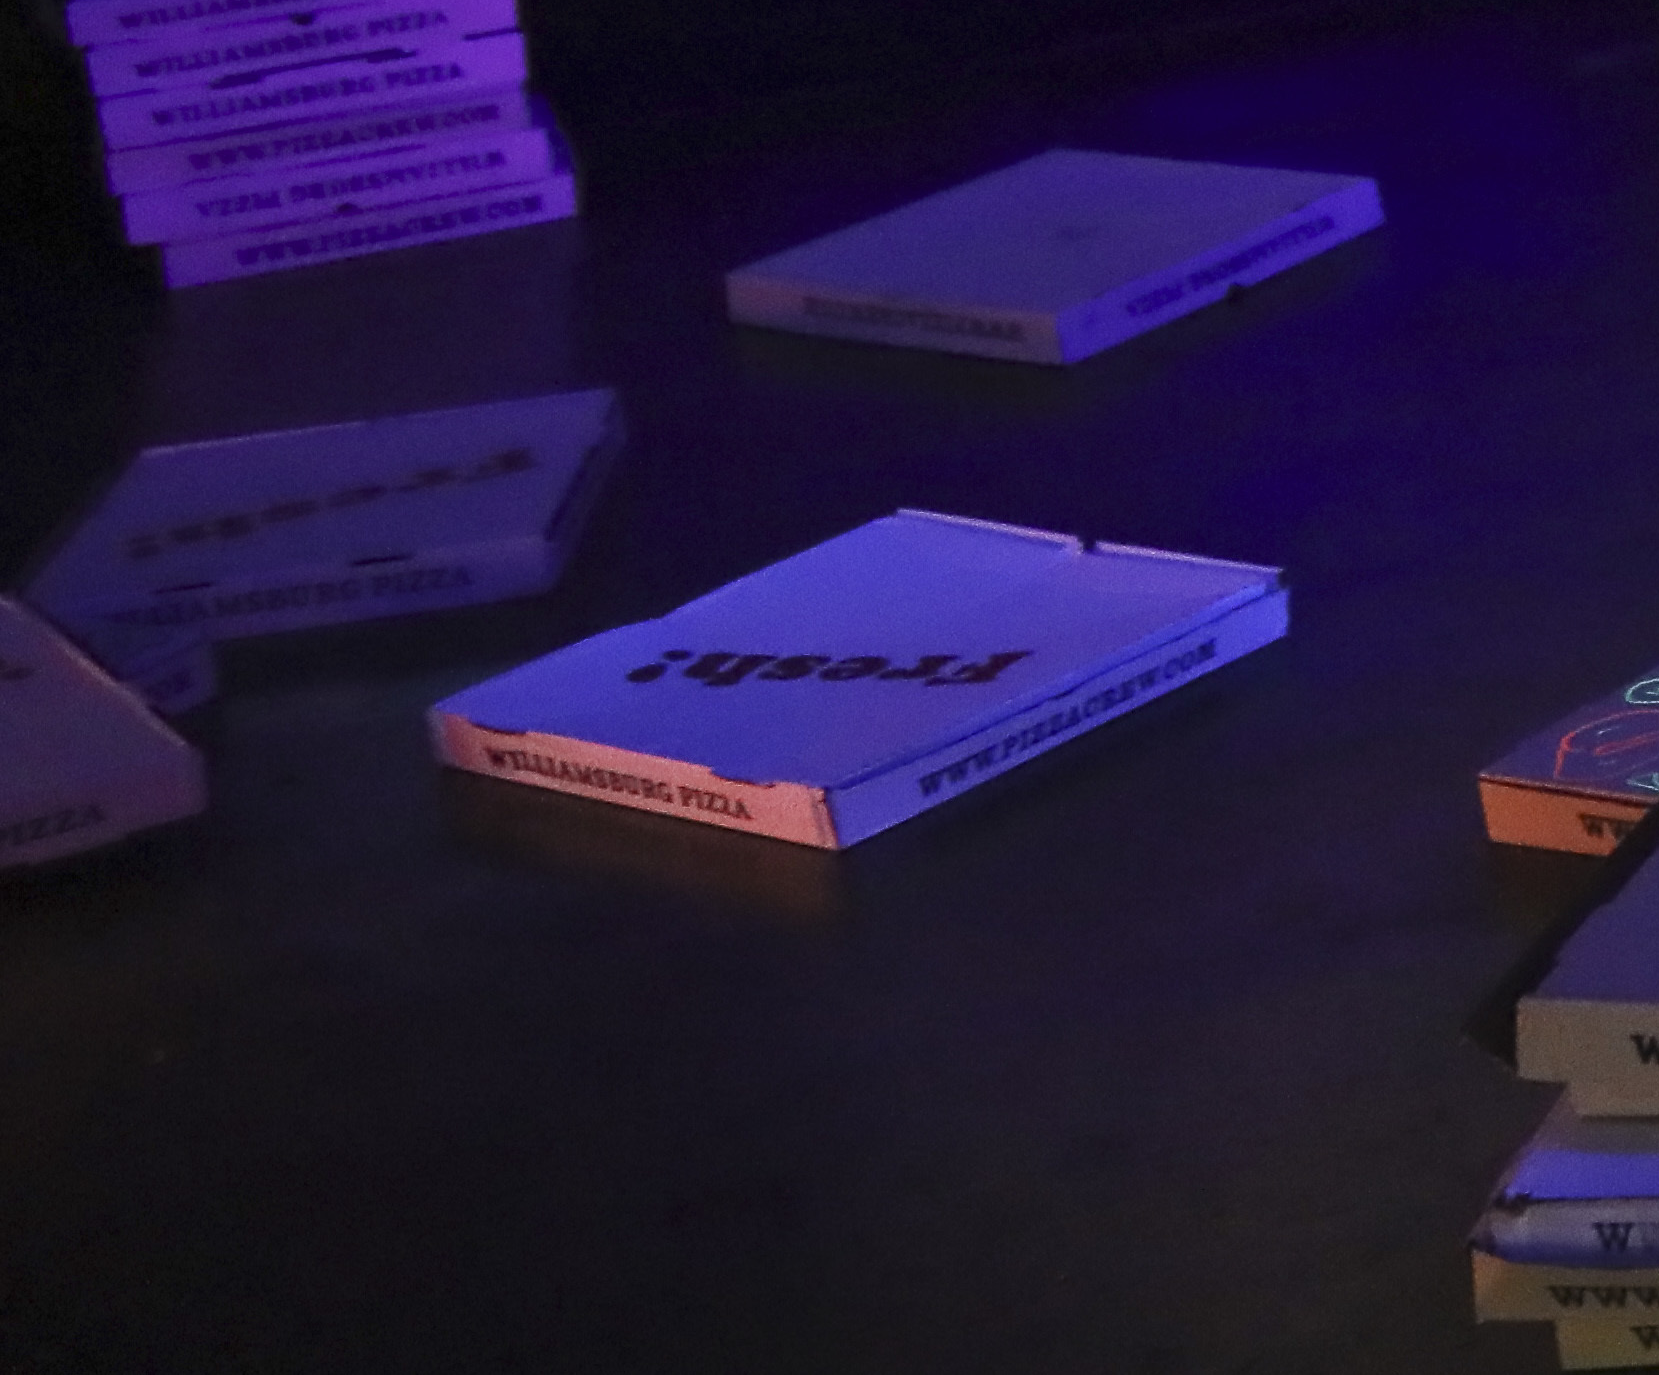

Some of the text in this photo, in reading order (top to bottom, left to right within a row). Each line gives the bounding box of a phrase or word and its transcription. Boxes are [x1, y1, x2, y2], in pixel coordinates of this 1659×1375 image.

[386, 63, 462, 89] PIZZA
[484, 745, 754, 822] WILLIAMSBURG PIZZA
